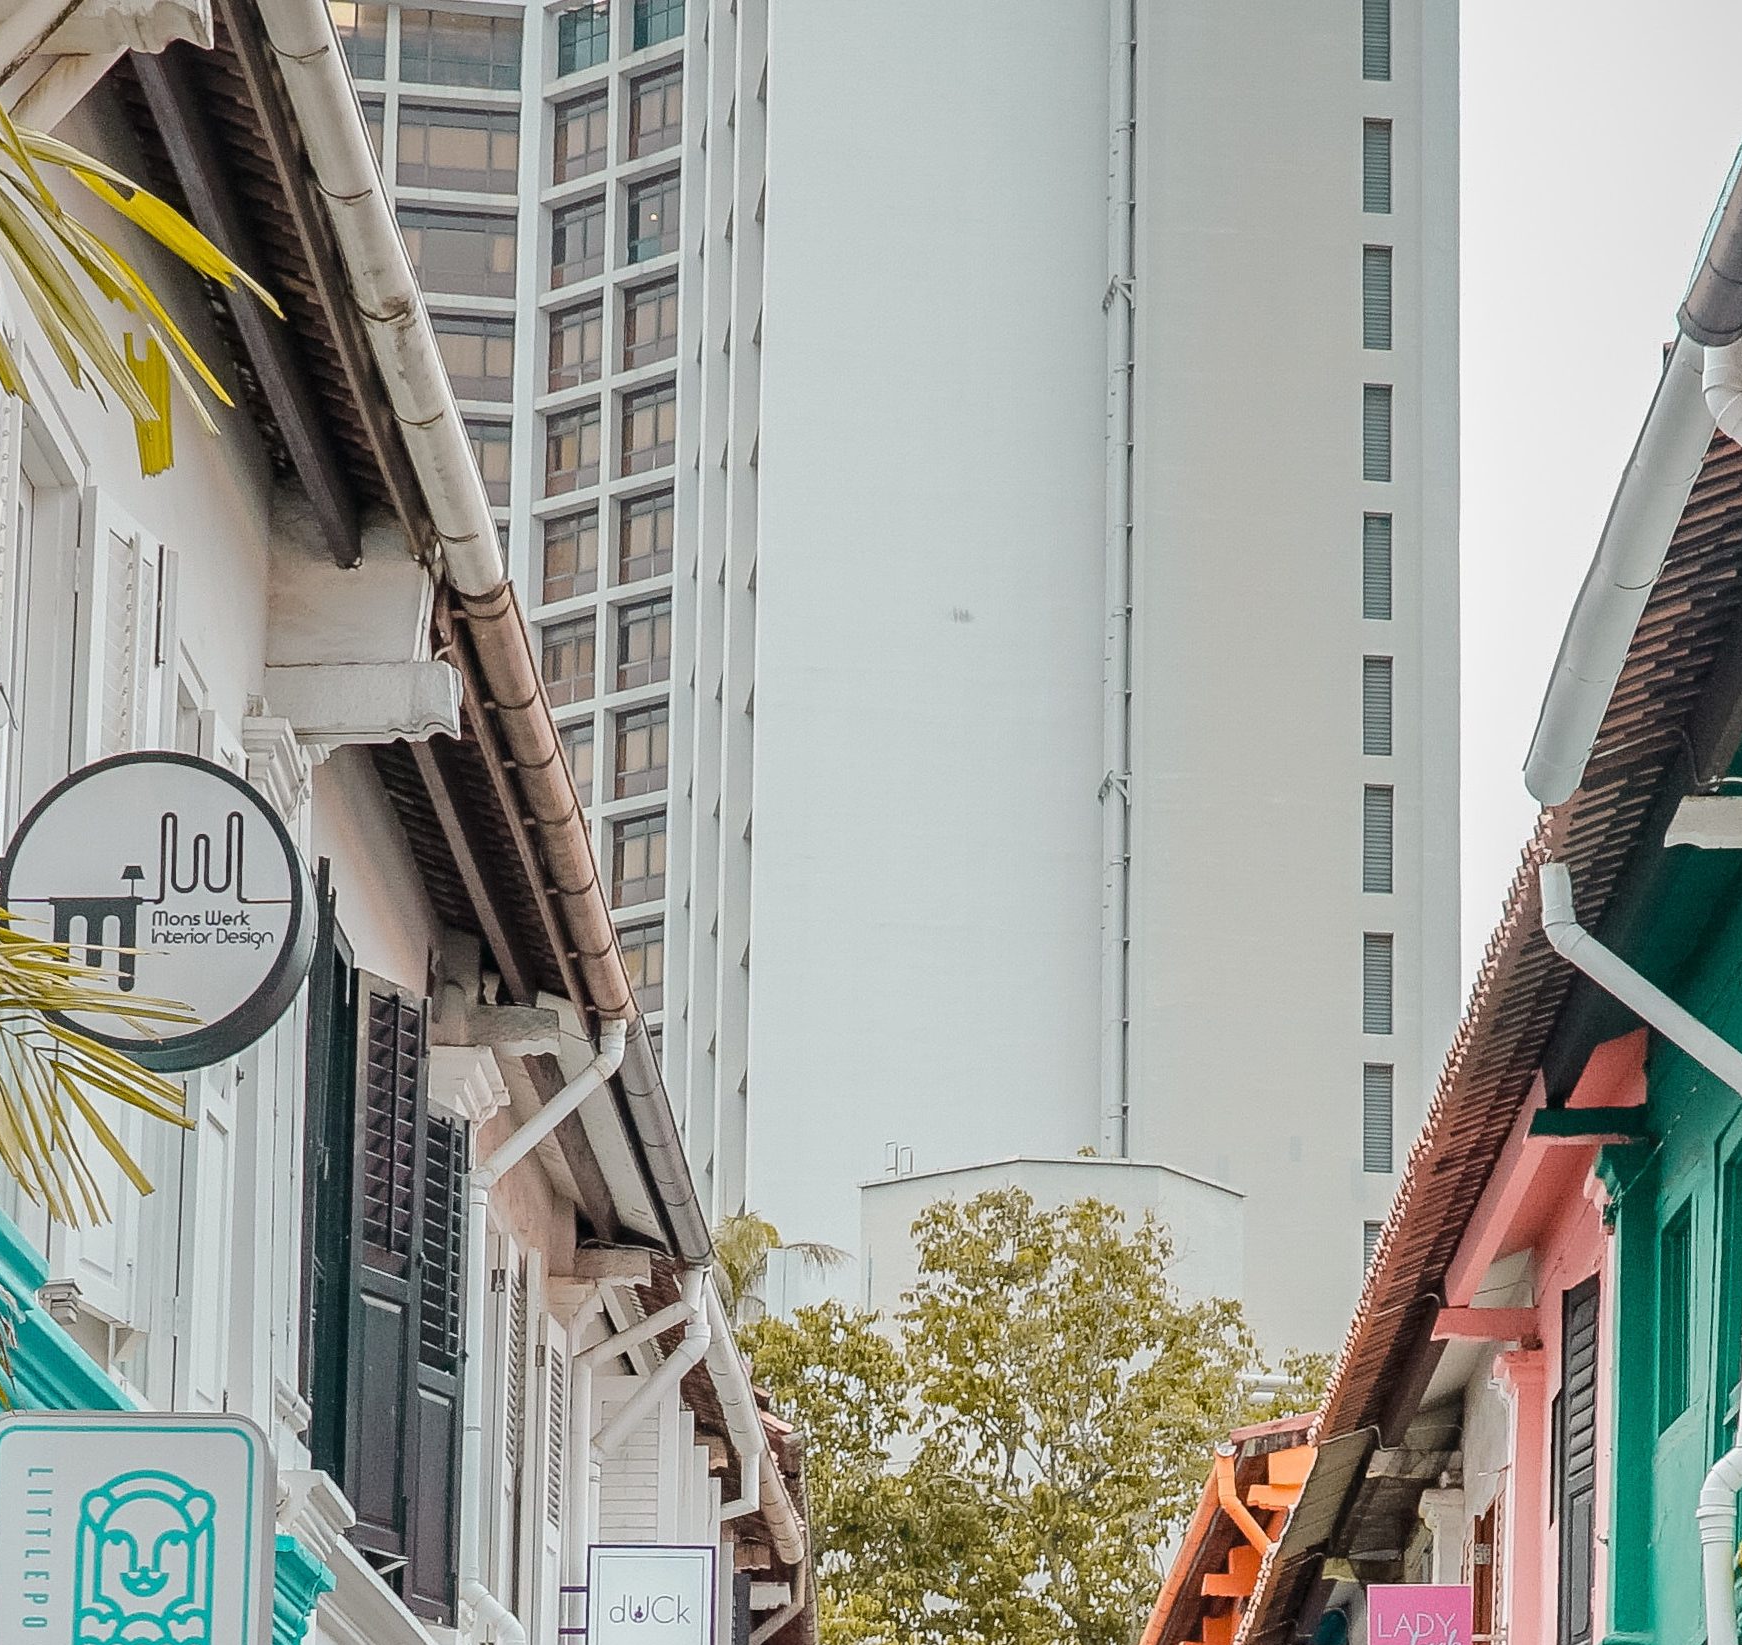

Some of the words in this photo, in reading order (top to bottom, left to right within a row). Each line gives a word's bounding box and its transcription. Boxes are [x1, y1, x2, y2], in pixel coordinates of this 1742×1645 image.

[152, 910, 201, 926] Mons
[205, 910, 250, 927] Werk
[151, 928, 213, 945] Interior
[215, 928, 274, 950] Design
[1377, 1612, 1457, 1638] LADY
